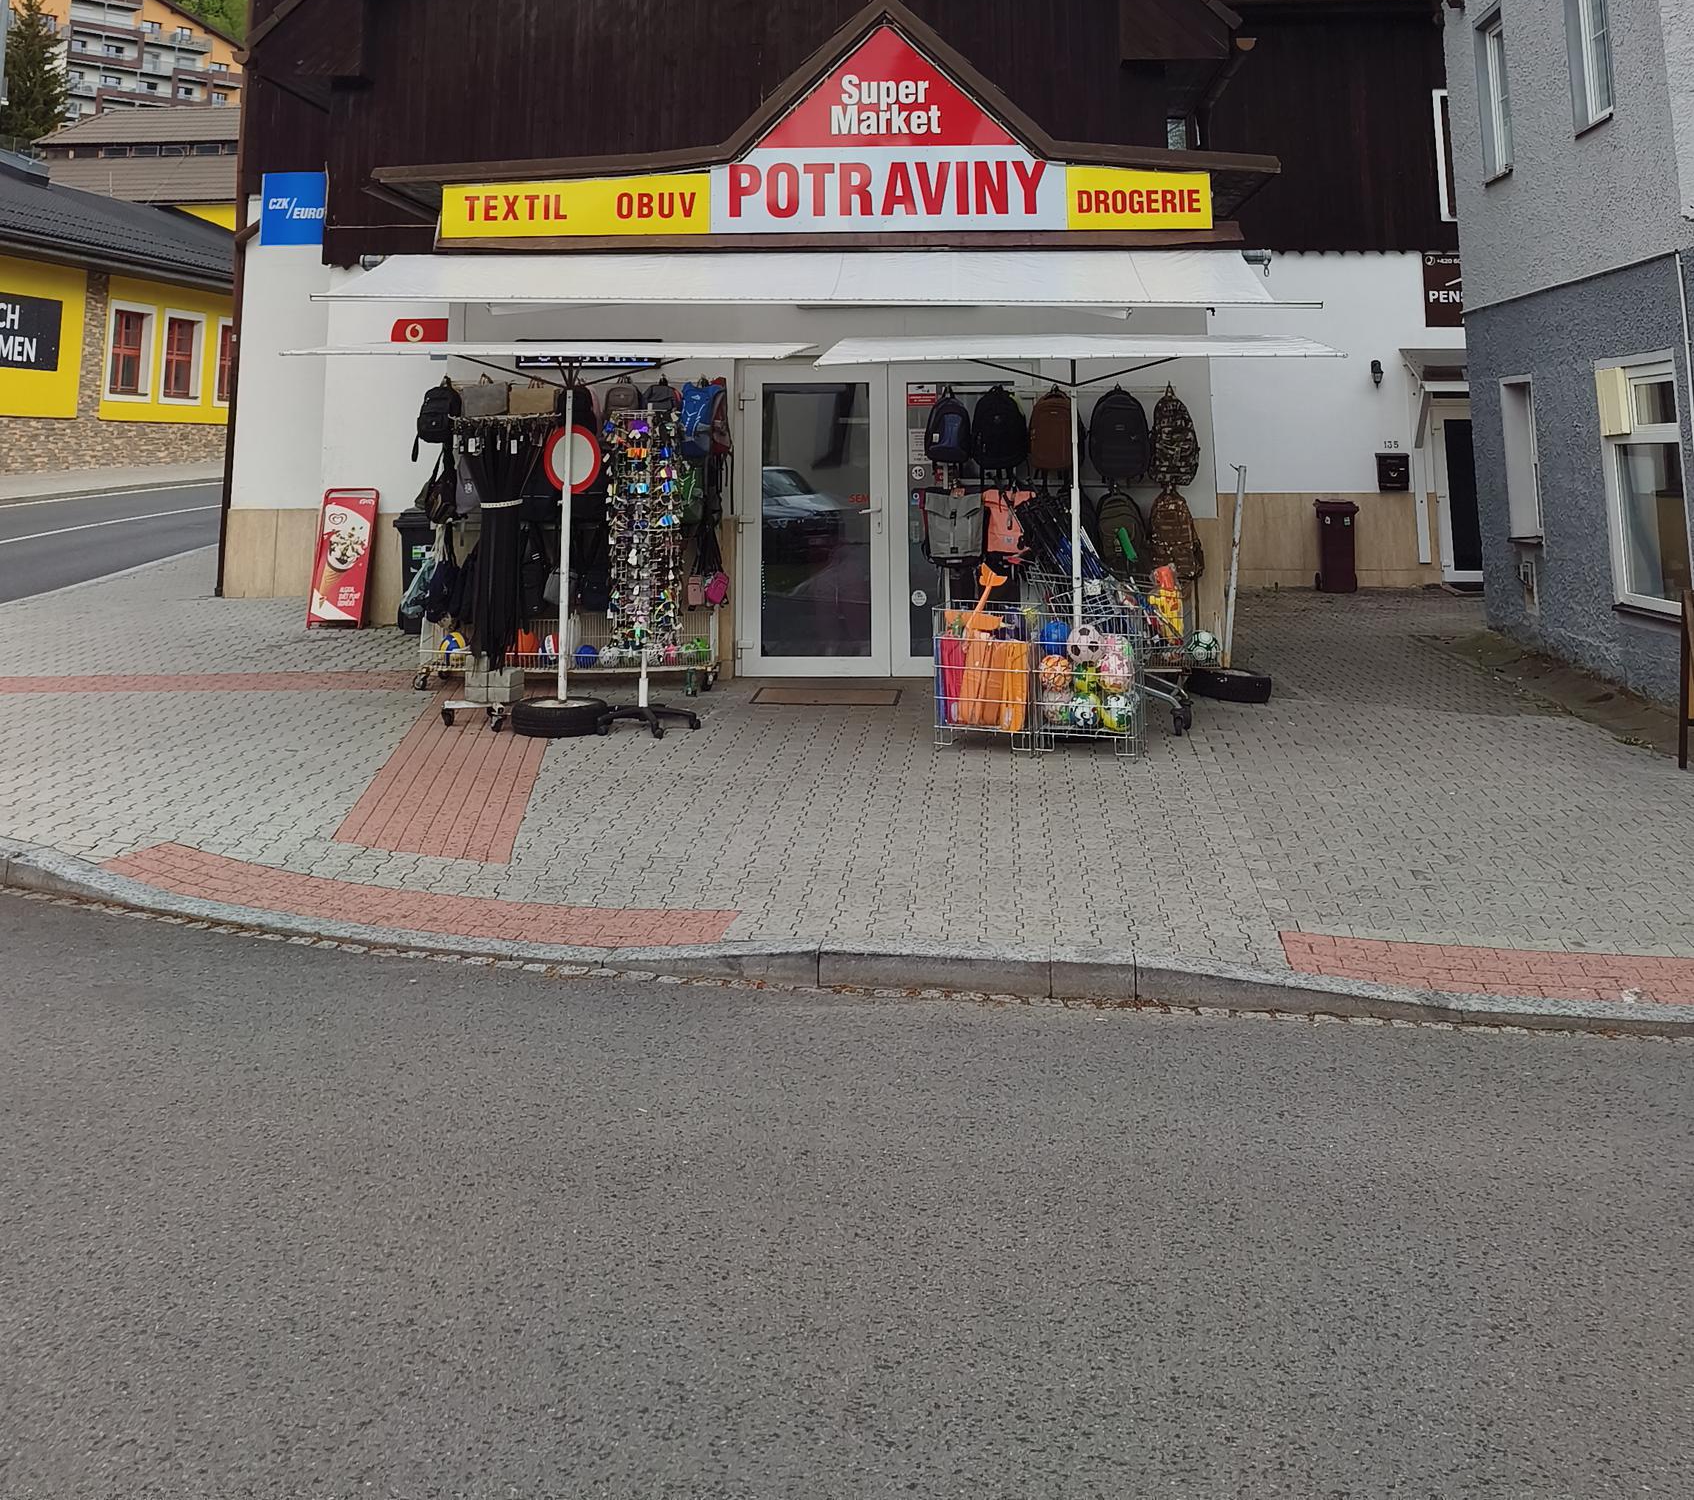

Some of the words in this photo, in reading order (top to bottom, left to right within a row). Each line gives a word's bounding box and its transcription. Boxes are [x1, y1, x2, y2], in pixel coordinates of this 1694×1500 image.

[841, 74, 929, 111] Super
[831, 105, 941, 135] Market
[729, 161, 1047, 218] POTRAVINY
[1077, 189, 1201, 214] DROGERIE
[464, 194, 567, 222] TEXTIL
[616, 192, 696, 220] OBUV
[1428, 290, 1463, 303] PEN
[1384, 441, 1399, 449] 135
